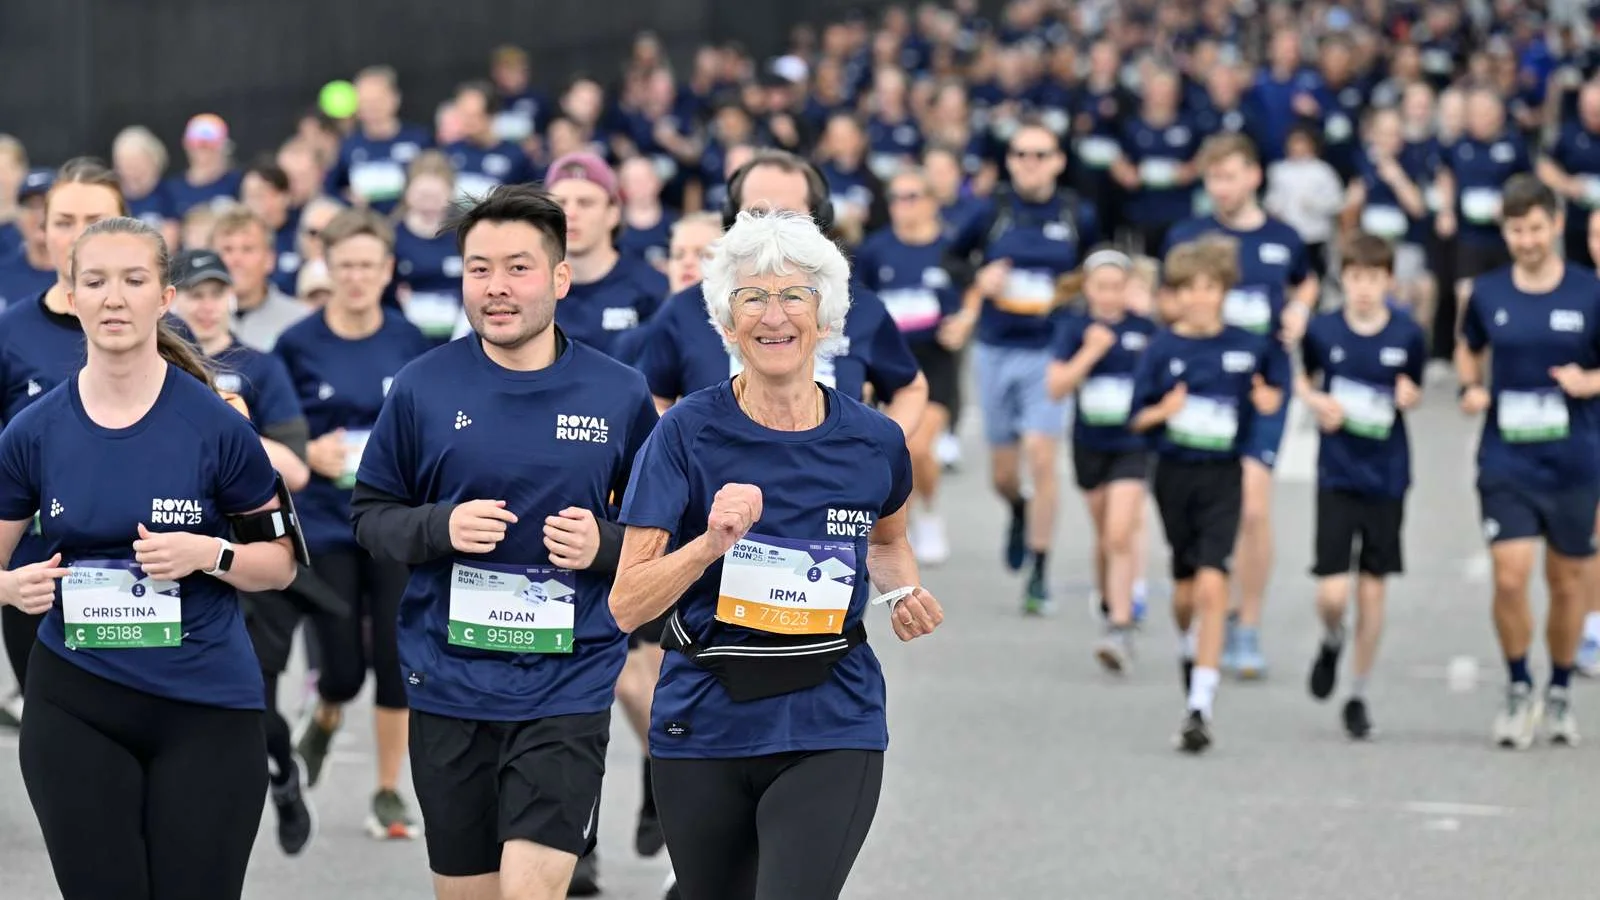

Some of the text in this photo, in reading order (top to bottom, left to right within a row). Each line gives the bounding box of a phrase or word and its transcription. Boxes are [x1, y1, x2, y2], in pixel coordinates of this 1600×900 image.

[557, 414, 609, 431] ROYAL
[152, 498, 203, 512] ROYAL
[827, 508, 873, 525] ROYAL
[733, 543, 764, 555] ROYAL
[458, 569, 484, 580] ROYAL
[769, 588, 808, 603] IRMA
[83, 606, 157, 618] CHRISTINA
[488, 610, 535, 623] AIDAN
[734, 604, 745, 618] B
[760, 606, 810, 626] 77623
[828, 614, 834, 627] 1
[76, 625, 170, 641] C 95188 1
[464, 628, 474, 640] C
[487, 628, 535, 645] 95189
[555, 633, 562, 646] 1
